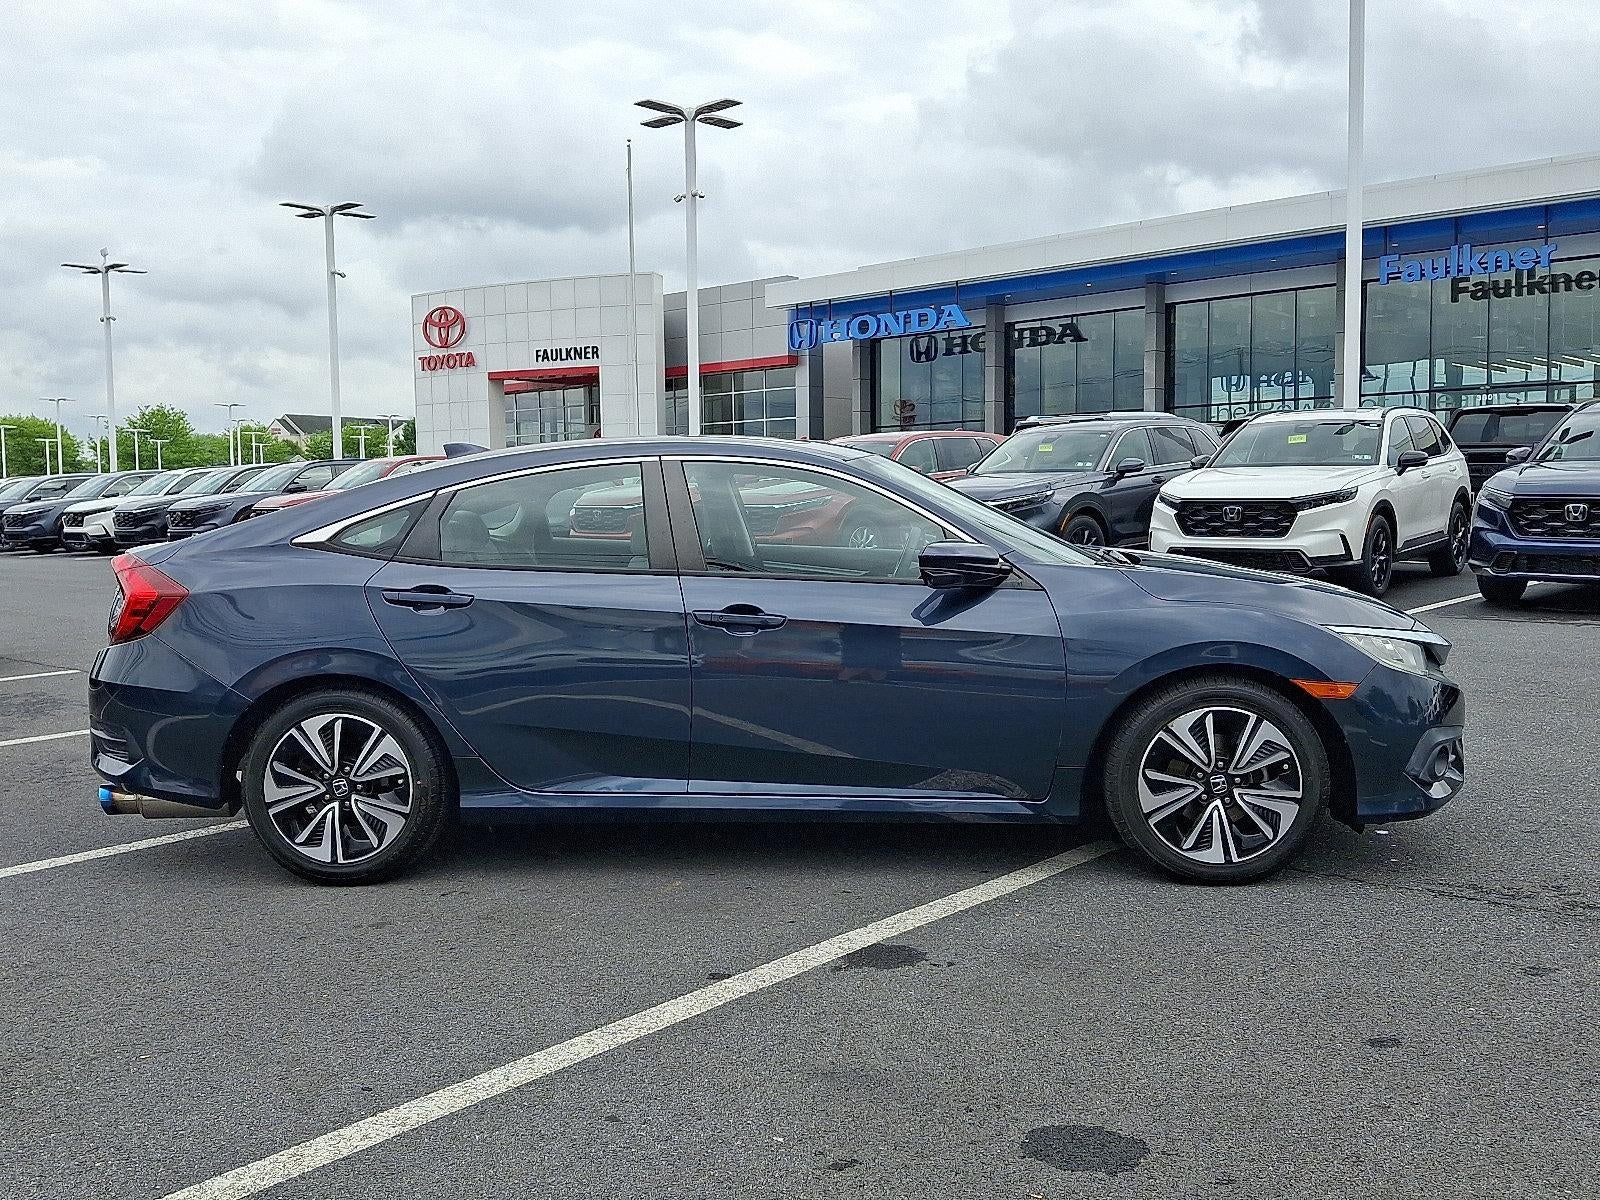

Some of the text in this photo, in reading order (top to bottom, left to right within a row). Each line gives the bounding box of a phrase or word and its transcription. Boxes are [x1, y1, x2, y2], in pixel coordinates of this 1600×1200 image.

[1379, 243, 1558, 286] Faulkner
[1451, 267, 1600, 303] Faulkne
[821, 303, 972, 344] HONDA
[418, 351, 476, 372] TOYOTA
[535, 345, 600, 363] FAULKNER
